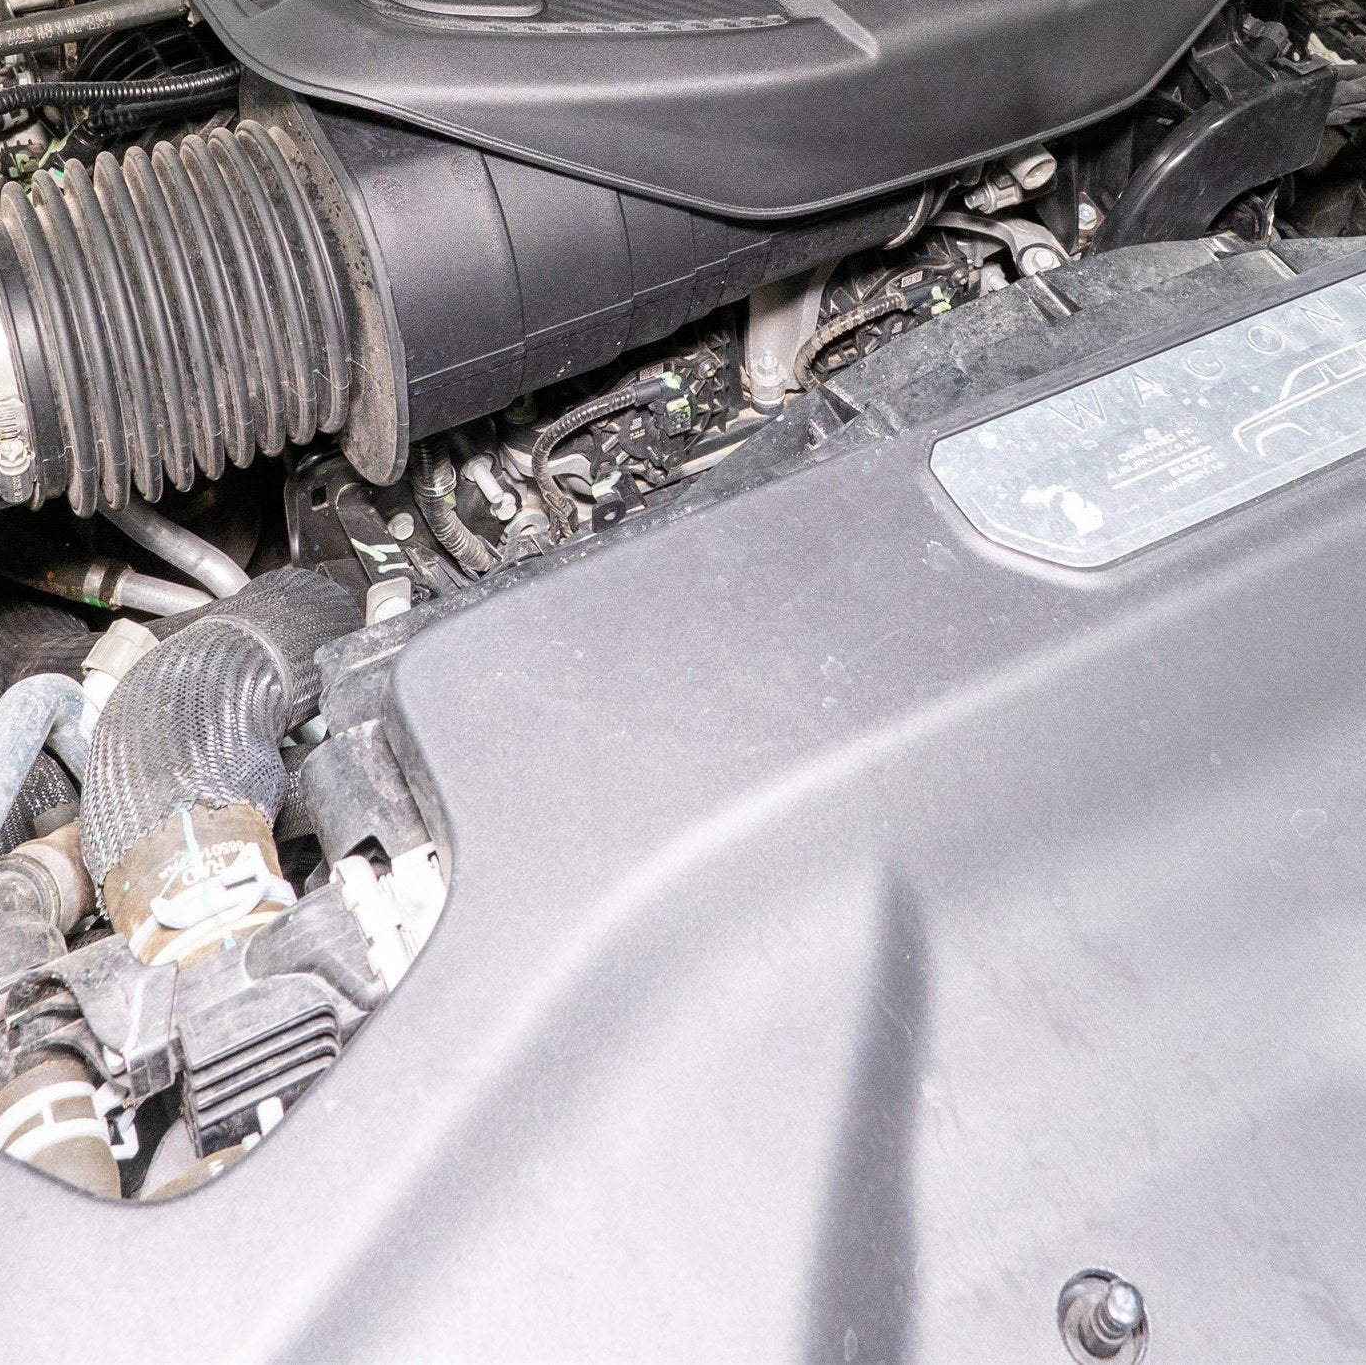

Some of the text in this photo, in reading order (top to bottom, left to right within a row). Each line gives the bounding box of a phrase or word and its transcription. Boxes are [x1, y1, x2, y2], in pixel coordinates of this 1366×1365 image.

[1107, 455, 1154, 481] AUBURN
[1186, 435, 1202, 447] MI
[1117, 433, 1176, 463] DESIGNED
[1158, 460, 1227, 494] WARREN, MI
[1168, 456, 1198, 477] BUILT
